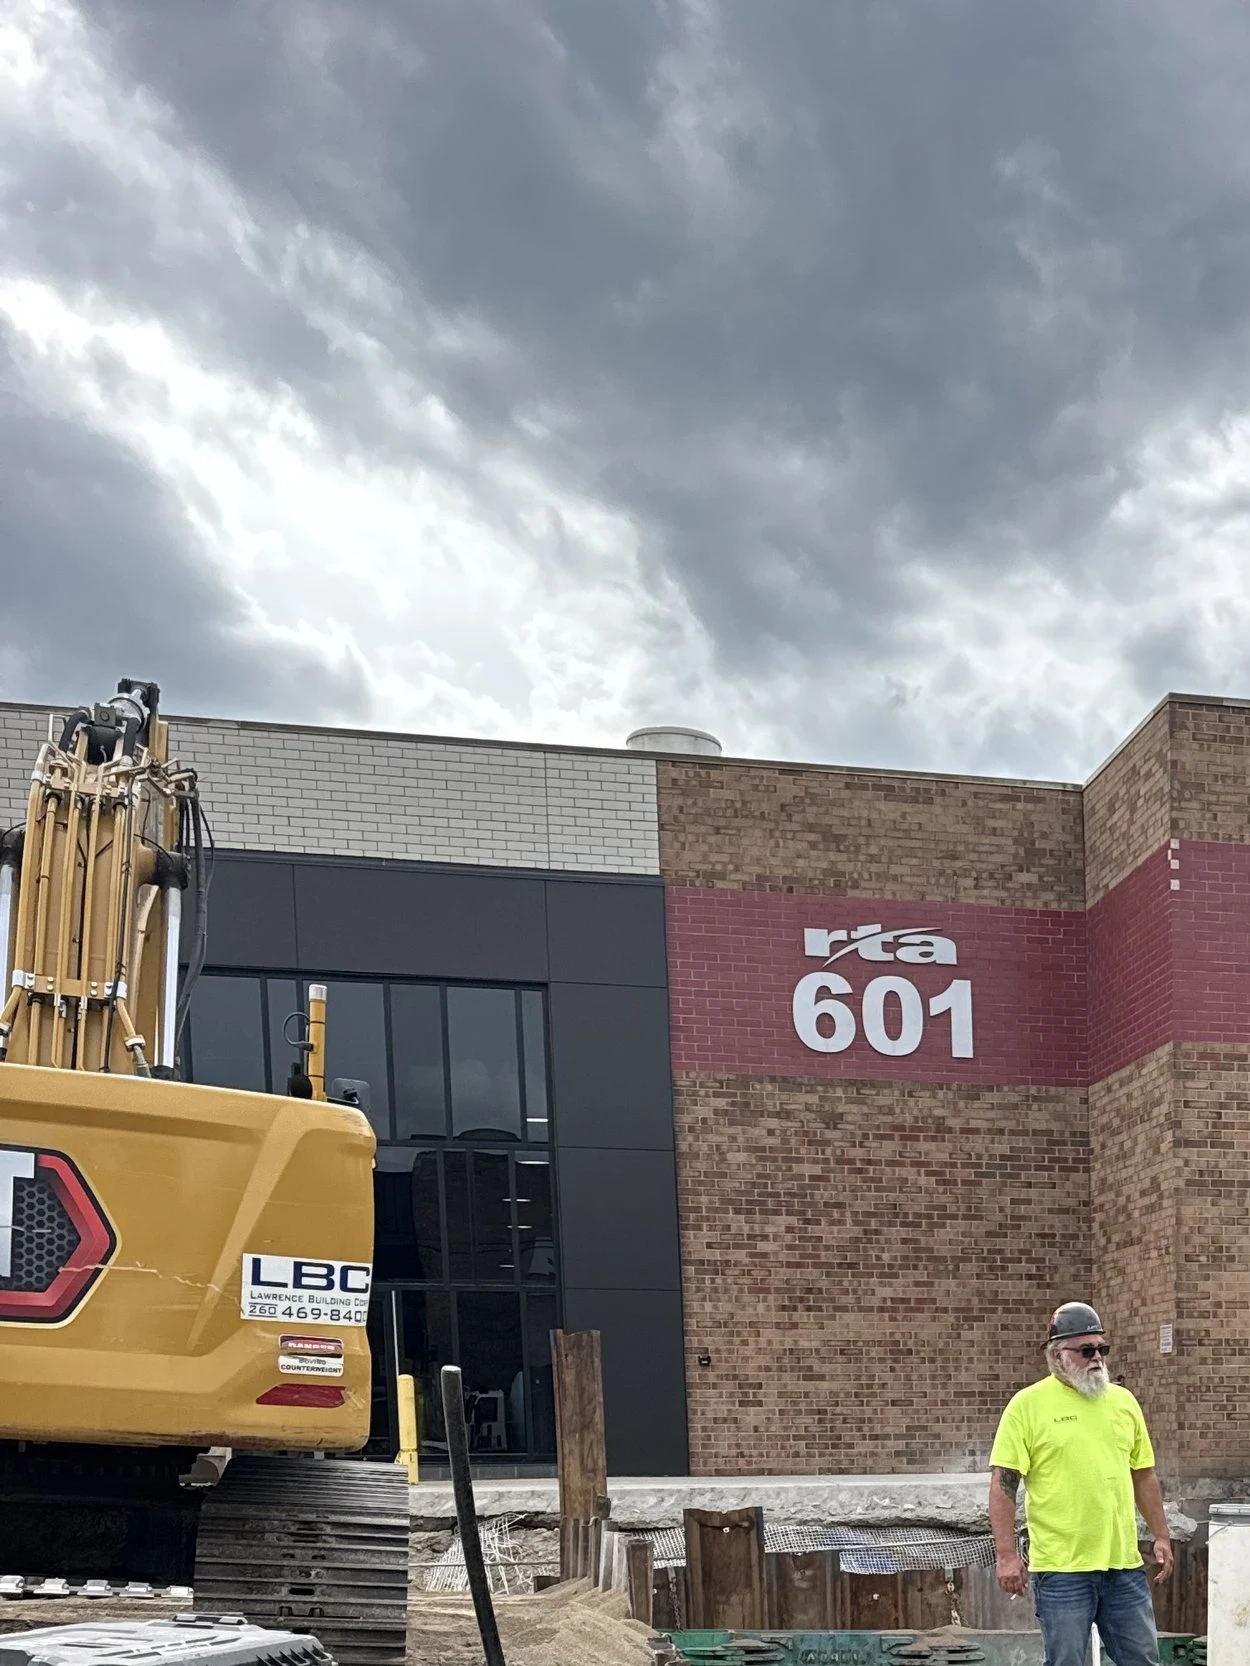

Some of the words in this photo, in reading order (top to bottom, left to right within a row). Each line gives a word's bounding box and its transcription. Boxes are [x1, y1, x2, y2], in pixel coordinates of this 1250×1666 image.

[804, 924, 957, 967] rta
[793, 971, 974, 1058] 601
[251, 1257, 370, 1294] LBC
[249, 1304, 277, 1316] 260
[280, 1364, 342, 1373] COUNTERWEIGHT
